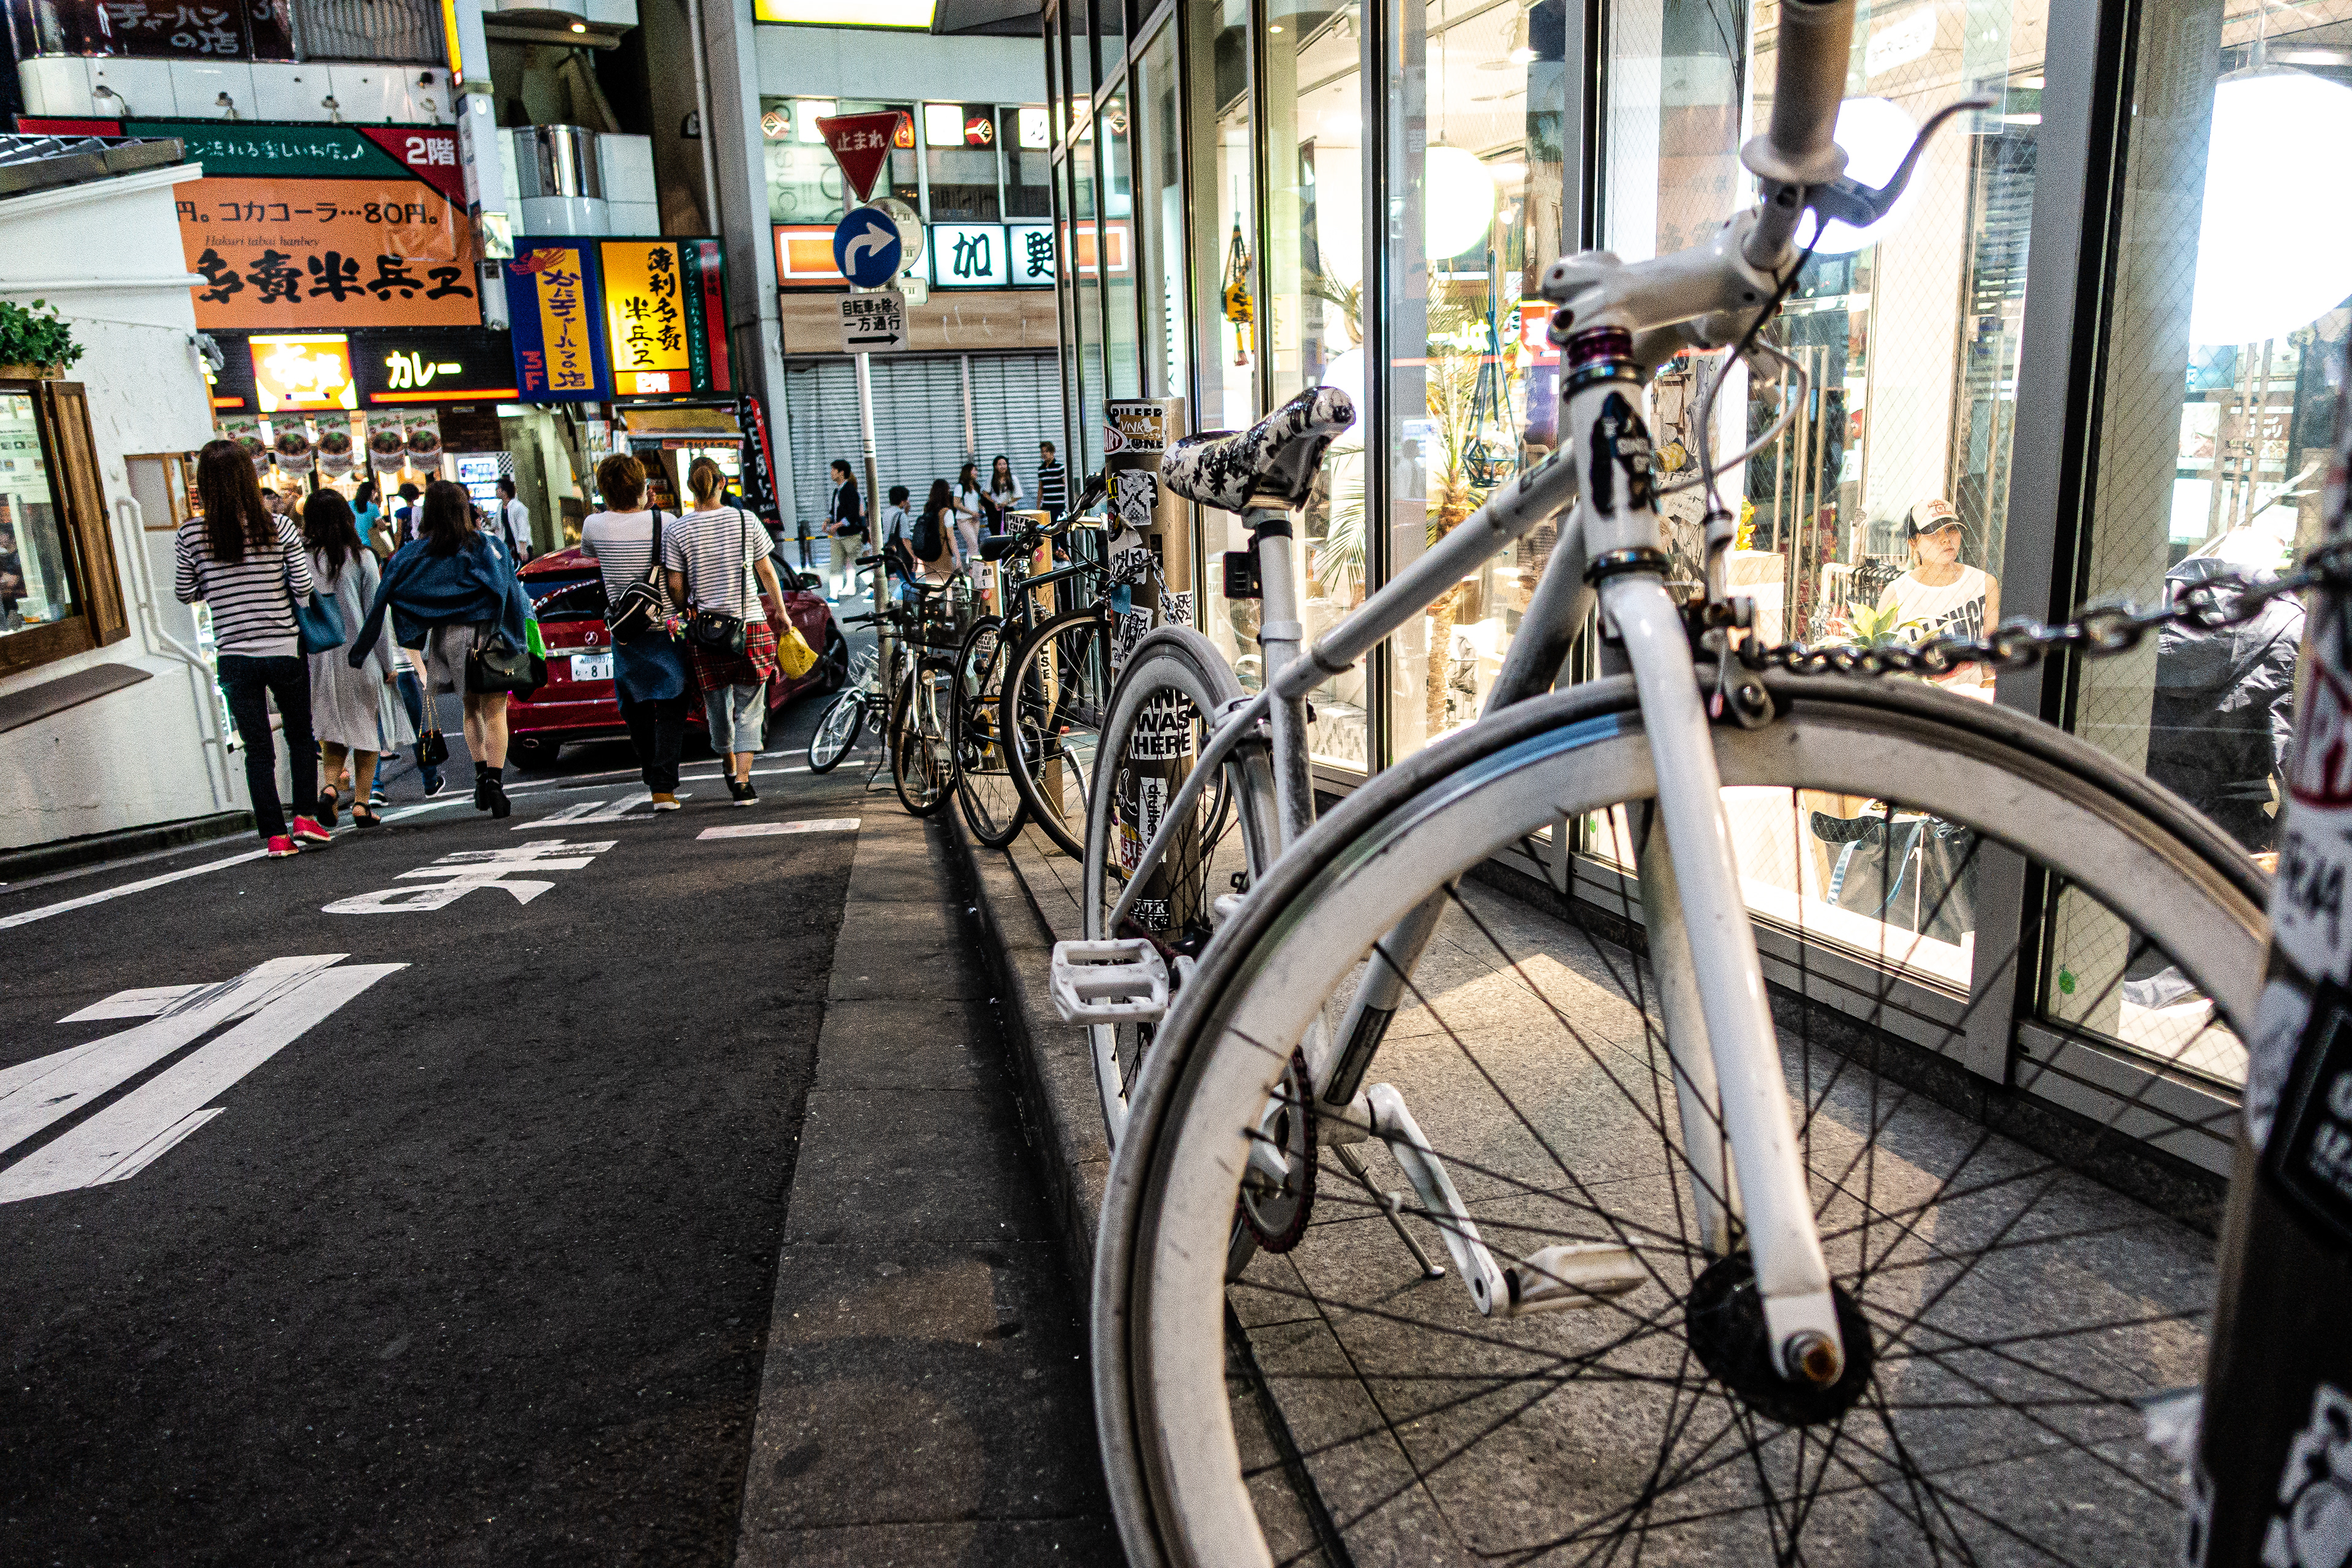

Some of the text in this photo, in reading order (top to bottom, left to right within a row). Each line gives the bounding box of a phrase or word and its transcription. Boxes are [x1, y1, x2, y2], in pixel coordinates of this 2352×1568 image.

[405, 137, 456, 166] 2階
[835, 129, 886, 152] 止まれ
[843, 315, 901, 332] 一方通行
[385, 349, 462, 389] カレー
[1137, 710, 1190, 732] WAS
[1134, 732, 1191, 755] HERE
